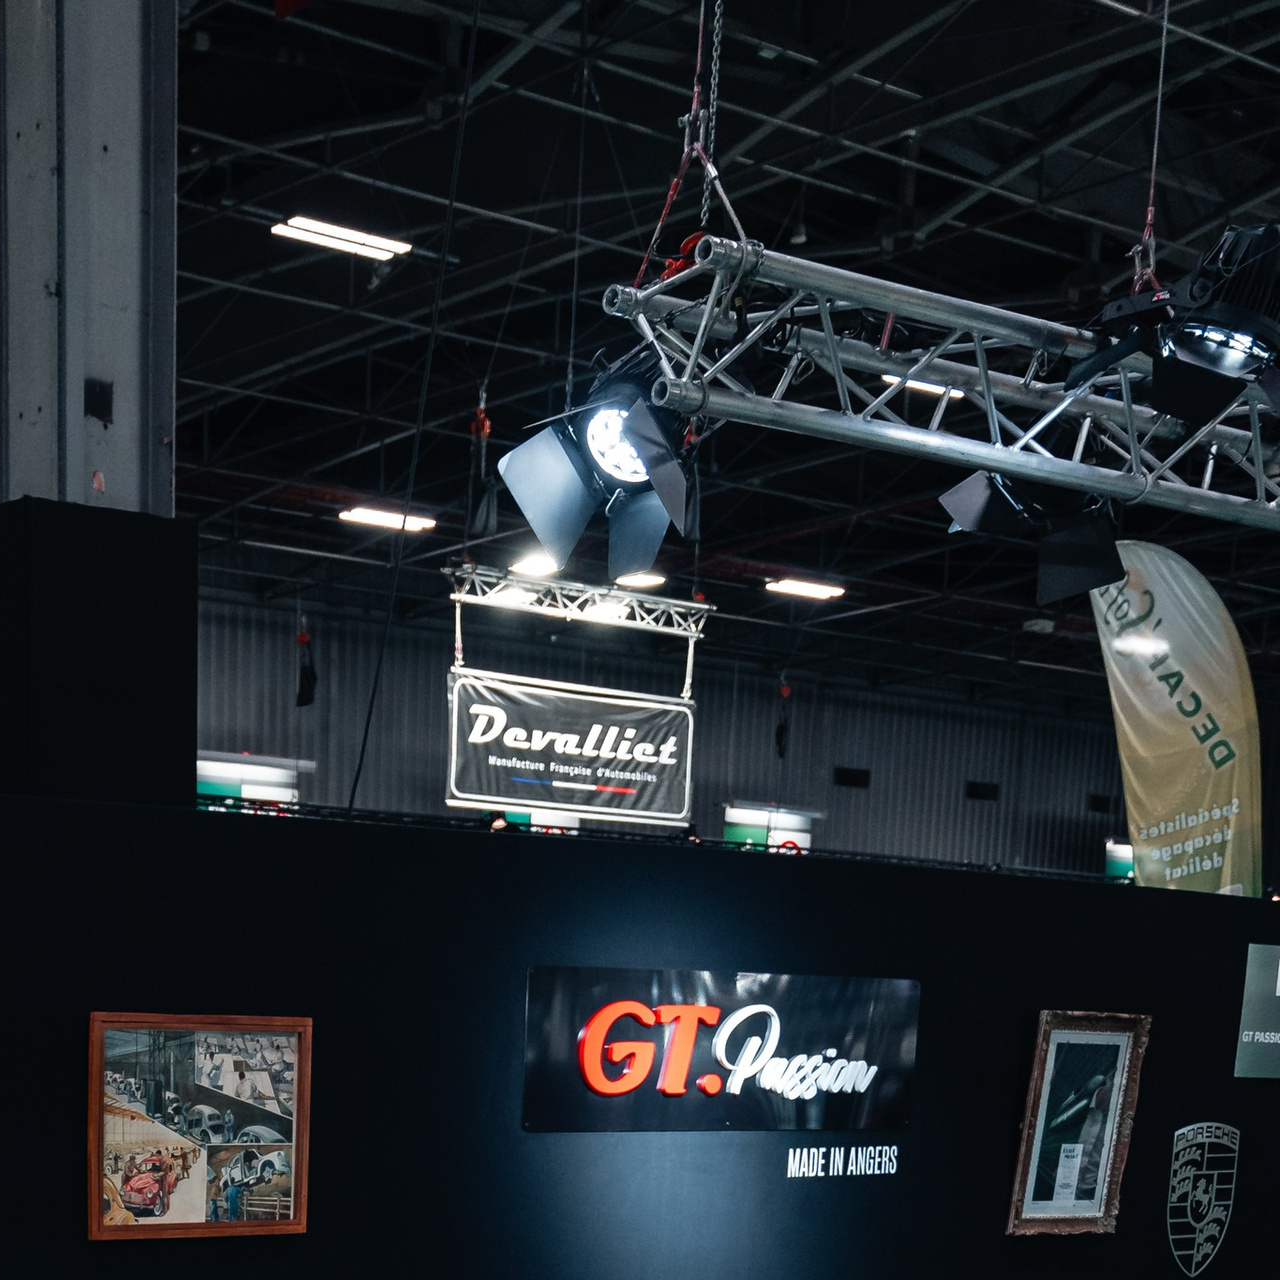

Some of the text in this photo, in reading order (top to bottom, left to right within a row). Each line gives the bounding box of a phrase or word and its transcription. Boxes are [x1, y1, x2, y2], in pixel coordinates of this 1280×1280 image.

[468, 703, 677, 765] Devalliet
[488, 755, 657, 783] Manufacture Française d'Automobiles
[711, 1004, 878, 1100] Passion
[1242, 1031, 1254, 1043] GT
[1176, 1125, 1238, 1149] PORSCHE
[787, 1145, 899, 1178] MADE IN ANGERS
